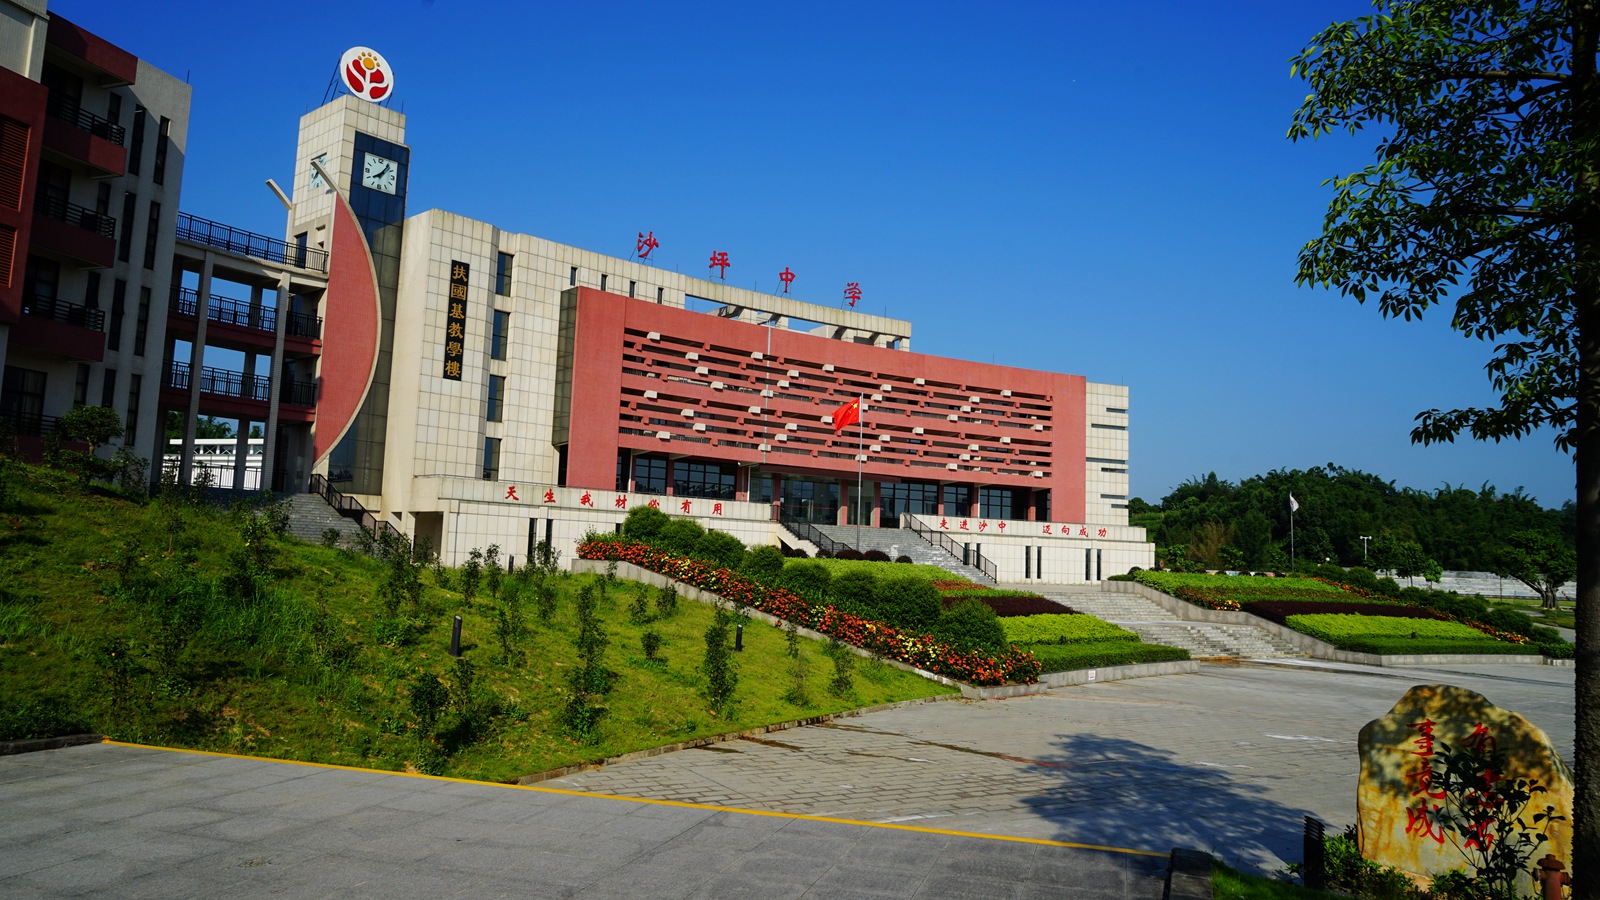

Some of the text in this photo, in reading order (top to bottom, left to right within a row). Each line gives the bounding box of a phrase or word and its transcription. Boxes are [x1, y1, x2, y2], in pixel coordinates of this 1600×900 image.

[637, 231, 863, 307] 沙坪中学
[445, 264, 468, 378] 扶國基教學樓
[505, 485, 723, 516] 天生我材必有用
[939, 517, 1107, 538] 走进沙中 迈向成功
